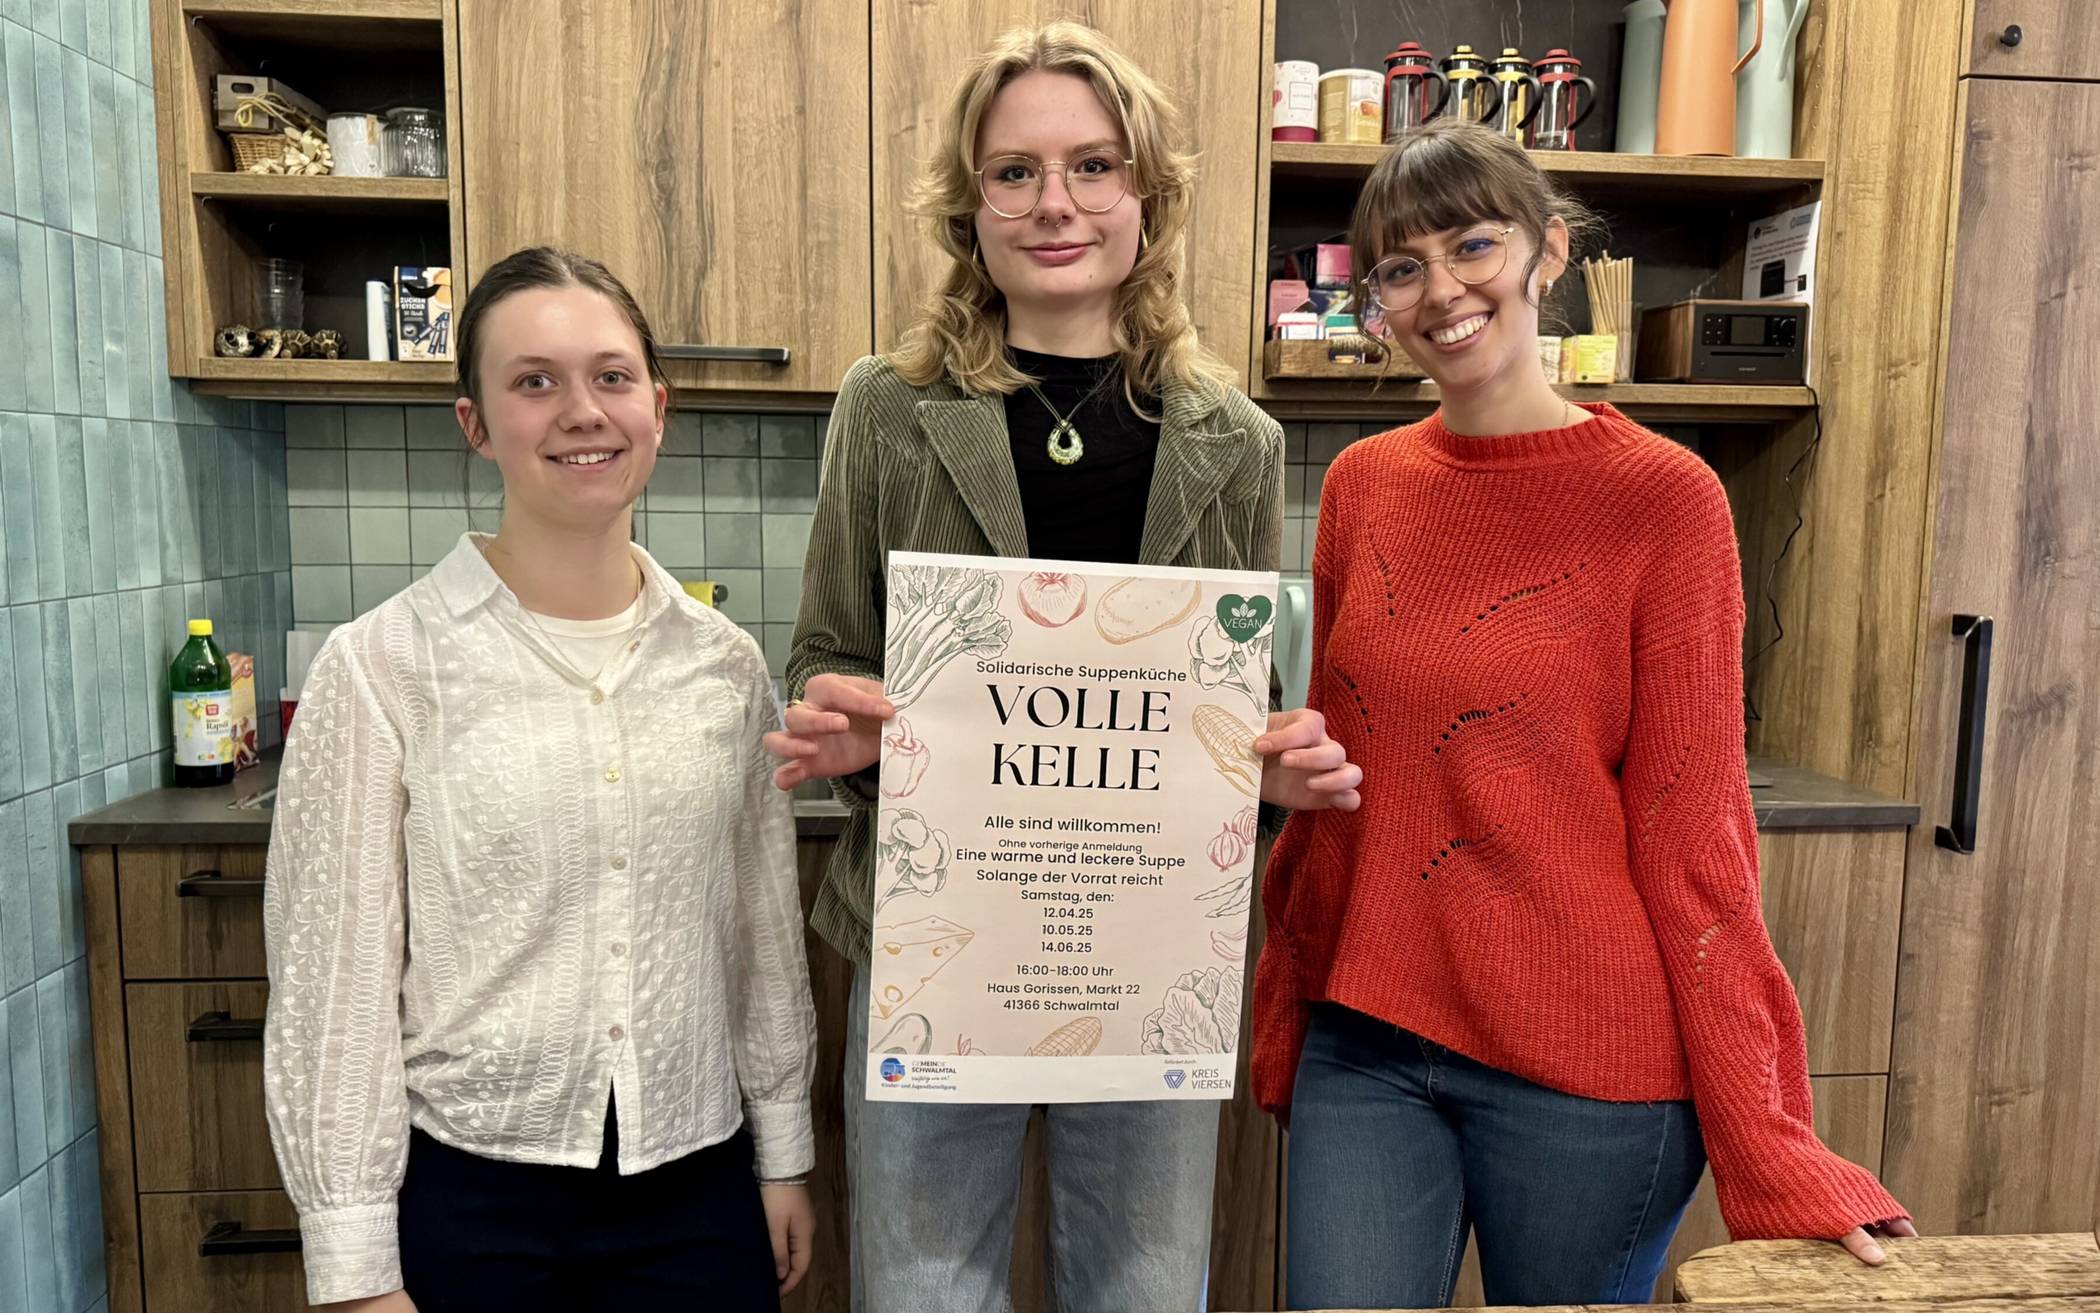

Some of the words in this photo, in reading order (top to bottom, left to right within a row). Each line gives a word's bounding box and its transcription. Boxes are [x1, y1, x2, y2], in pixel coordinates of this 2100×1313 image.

[1223, 618, 1263, 630] VEGAN
[977, 661, 1073, 676] Solidarische
[1078, 666, 1186, 682] Suppenküche
[986, 684, 1170, 732] VOLLE
[991, 743, 1160, 791] KELLE
[984, 816, 1014, 829] Alle
[1019, 816, 1053, 830] sind
[1058, 818, 1160, 834] willkommen!
[999, 839, 1026, 848] Ohne
[1029, 840, 1079, 852] vorherige
[1082, 842, 1142, 854] Anmeldung
[956, 848, 986, 861] Eine
[991, 852, 1043, 862] warme
[1048, 850, 1076, 864] und
[1080, 851, 1134, 865] leckere
[1139, 855, 1185, 870] Suppe
[976, 869, 1038, 884] Solange
[1042, 871, 1067, 883] der
[1071, 872, 1117, 884] Vorrat
[1121, 873, 1163, 885] reicht
[1021, 890, 1082, 904] Samstag,
[1086, 891, 1114, 902] den:
[1044, 907, 1093, 919] 12.04.25
[1042, 924, 1093, 936] 10.05.25
[1041, 941, 1092, 953] 14.06.25
[1092, 966, 1114, 976] Uhr
[988, 983, 1020, 993] Haus
[1024, 983, 1082, 995] Gorissen,
[1086, 985, 1123, 994] Markt
[1126, 984, 1140, 994] 22
[1003, 1000, 1039, 1010] 41366
[1044, 1001, 1119, 1011] Schwalmtal
[1192, 1069, 1219, 1078] KREIS
[1192, 1080, 1231, 1089] VIERSEN
